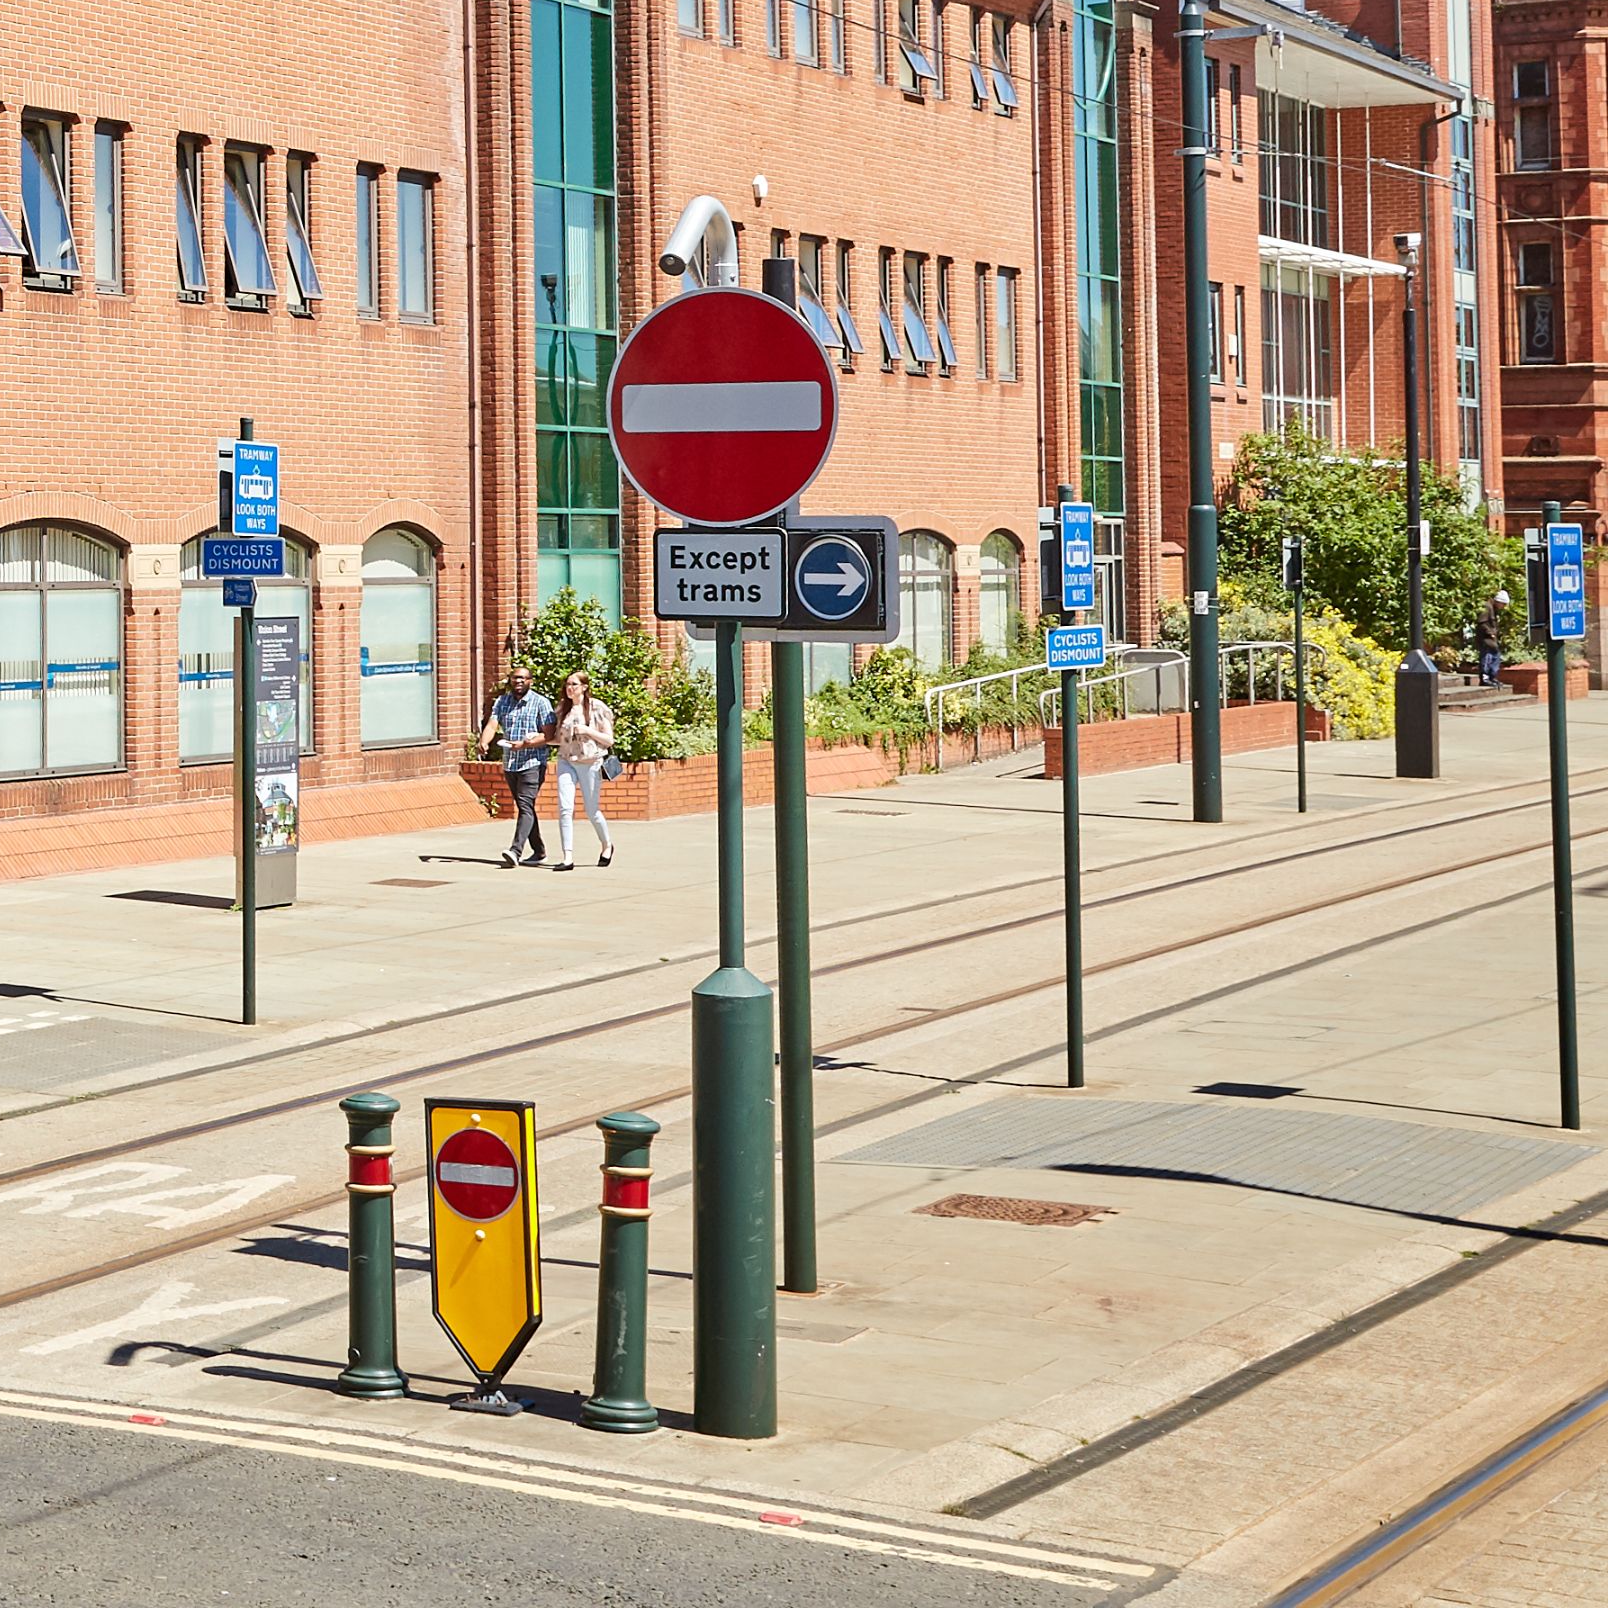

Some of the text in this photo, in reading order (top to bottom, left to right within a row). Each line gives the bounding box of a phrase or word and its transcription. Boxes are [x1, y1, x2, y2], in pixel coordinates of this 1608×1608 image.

[238, 448, 274, 462] TRAMWAY
[236, 503, 276, 517] LOOK BOTH
[246, 518, 266, 530] WAYS
[1065, 511, 1090, 524] TRAMWAY
[212, 544, 274, 557] CYCLISTS
[208, 558, 279, 570] DISMOUNT
[670, 545, 770, 574] Except
[676, 578, 762, 602] trams
[1053, 632, 1098, 647] CYCLISTS
[1051, 647, 1102, 662] DISMOUNT
